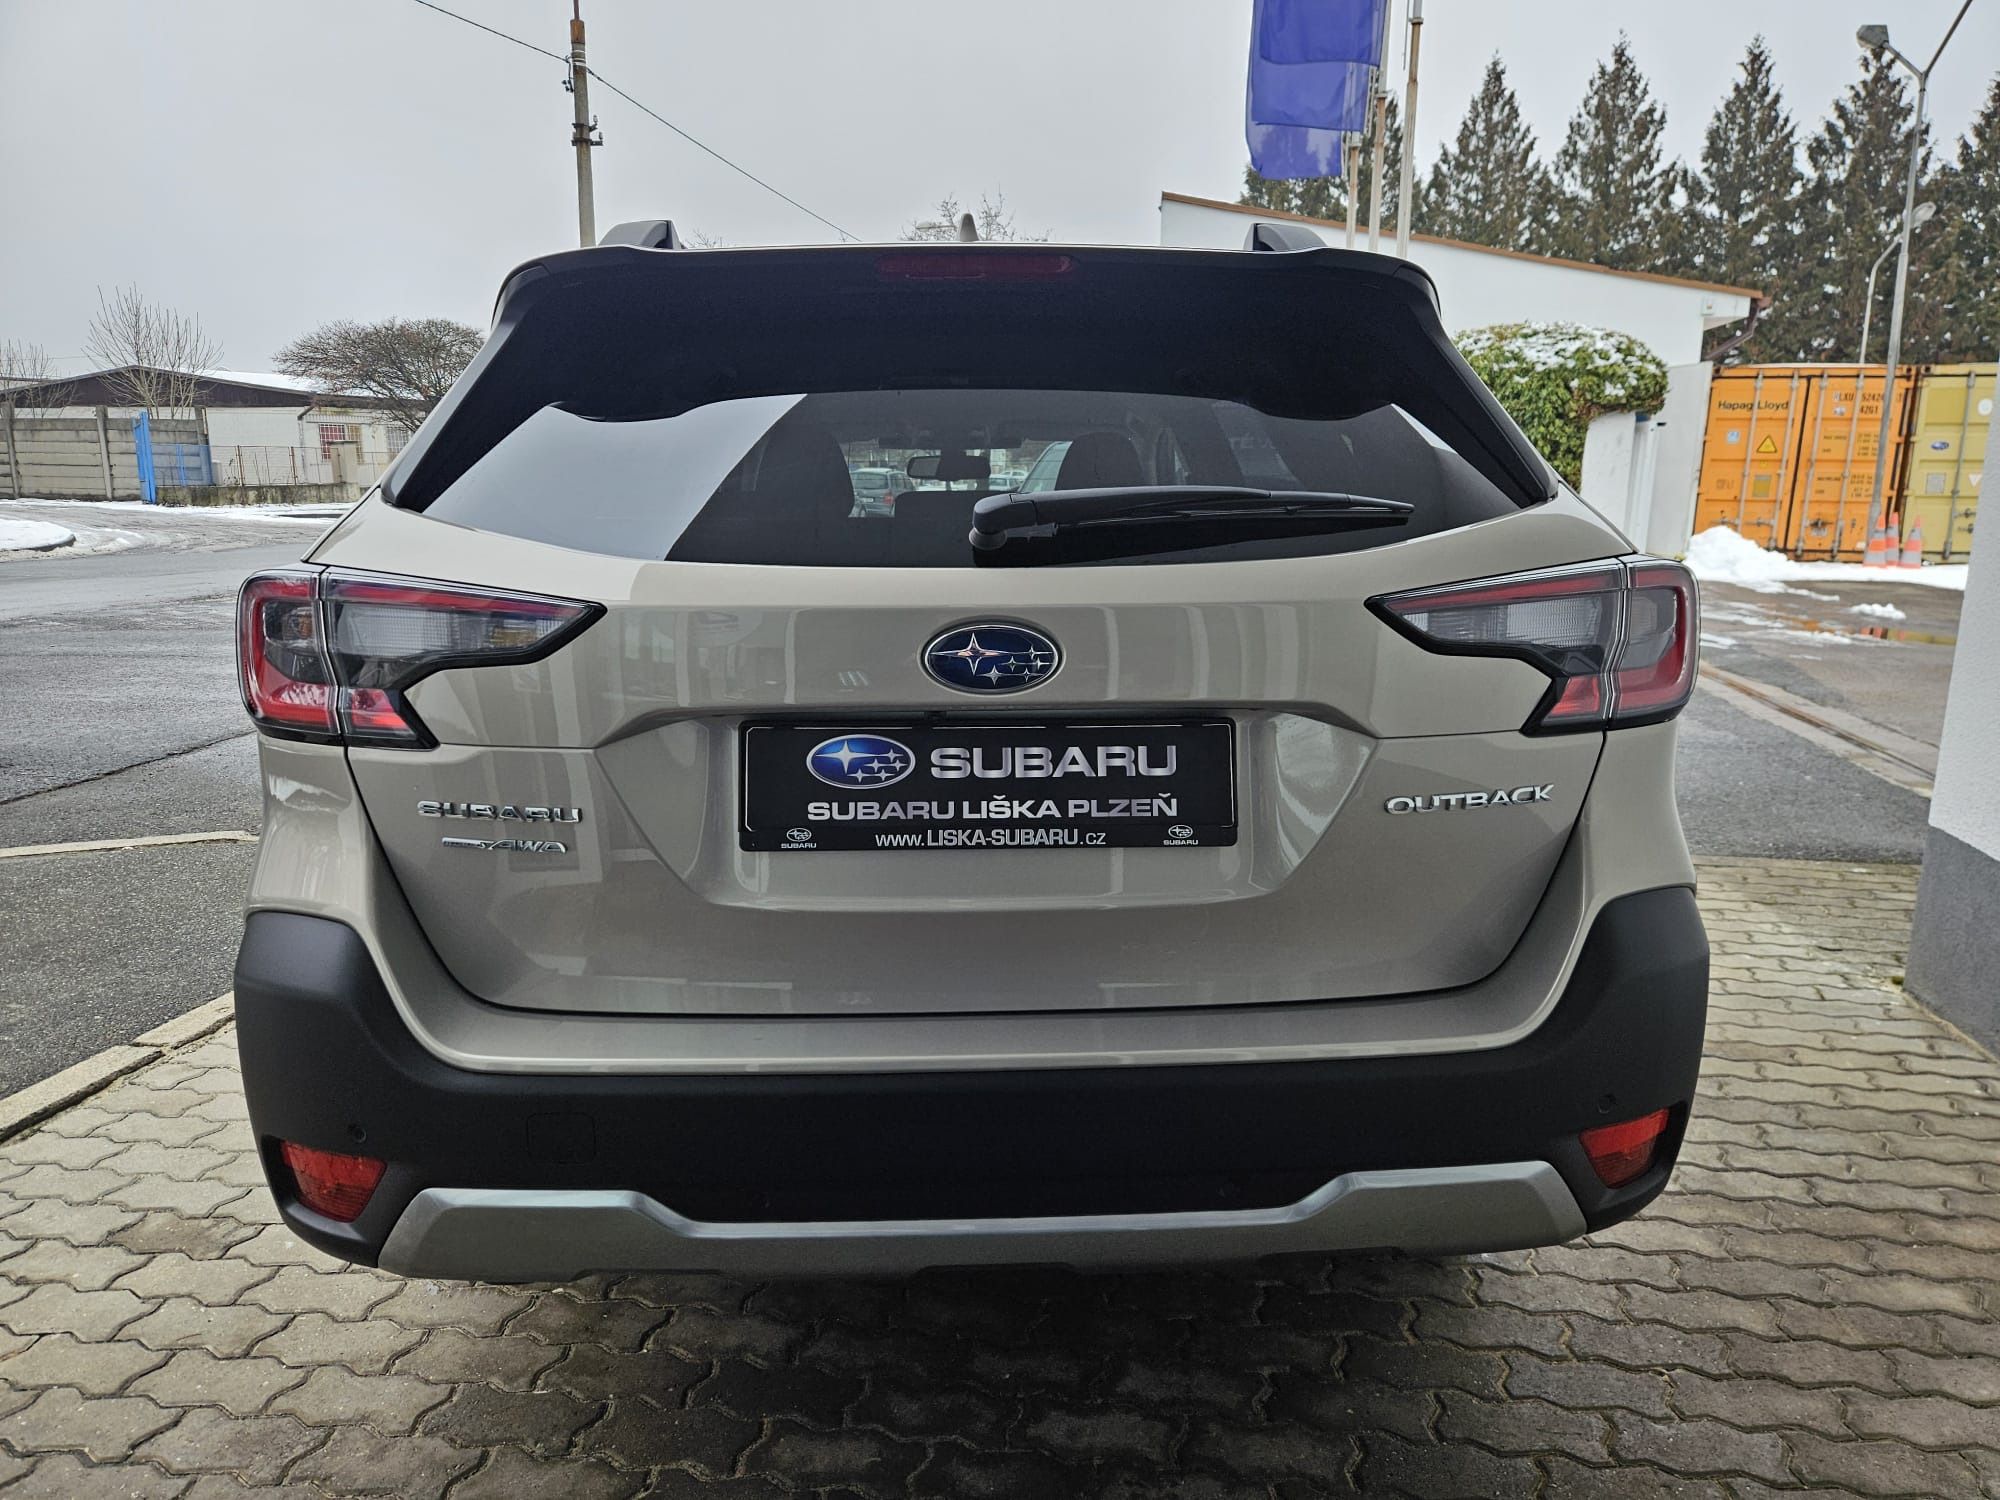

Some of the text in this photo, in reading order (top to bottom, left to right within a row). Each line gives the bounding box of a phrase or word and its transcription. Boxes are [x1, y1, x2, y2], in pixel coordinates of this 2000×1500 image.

[1718, 400, 1789, 412] Hapag Lloyd
[930, 745, 1177, 779] SUBARU
[417, 800, 583, 823] SUBARU
[807, 793, 1178, 821] SUBARU LIŠKA PLZEŇ
[1384, 783, 1555, 815] OUTBACK
